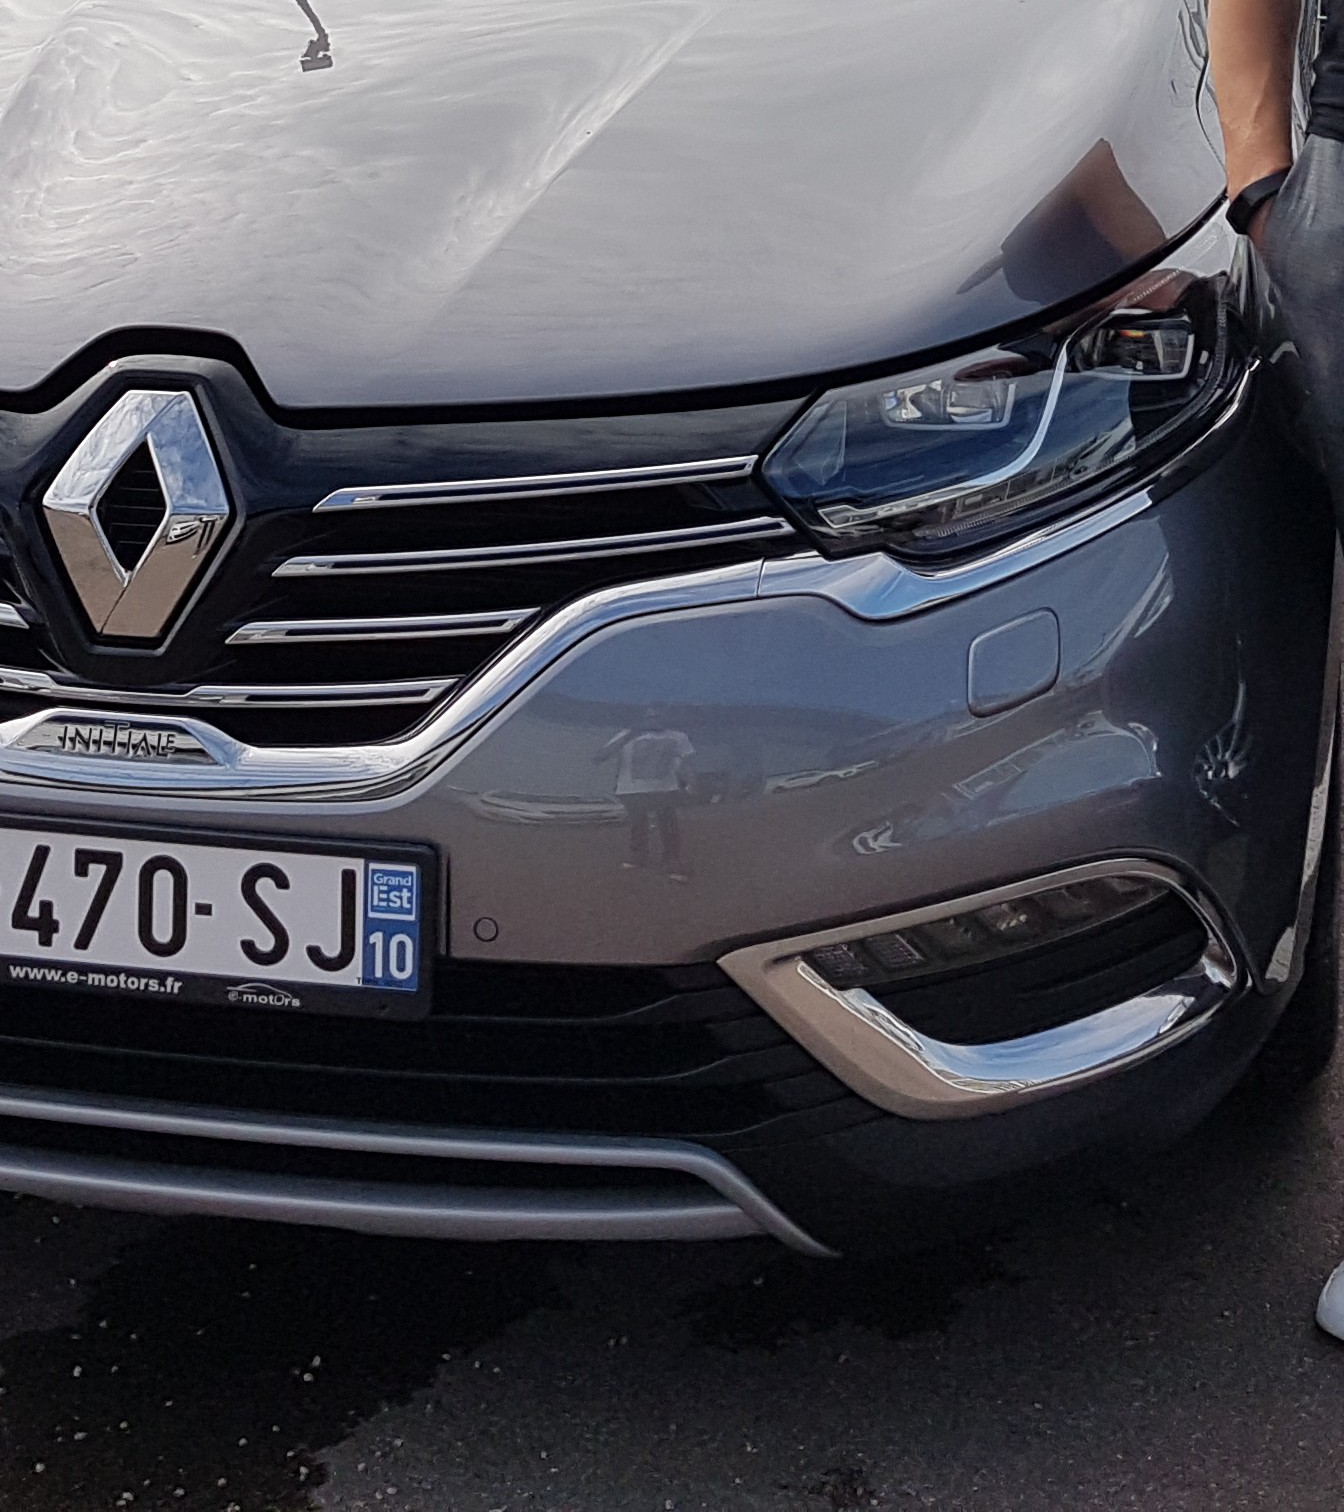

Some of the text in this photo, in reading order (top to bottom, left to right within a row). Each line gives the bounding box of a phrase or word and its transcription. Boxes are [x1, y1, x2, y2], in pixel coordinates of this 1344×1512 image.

[60, 719, 177, 759] INITIALE
[373, 872, 412, 887] Grand
[373, 885, 412, 909] Est
[369, 931, 414, 980] 10
[9, 964, 183, 994] www.e-motors.fr
